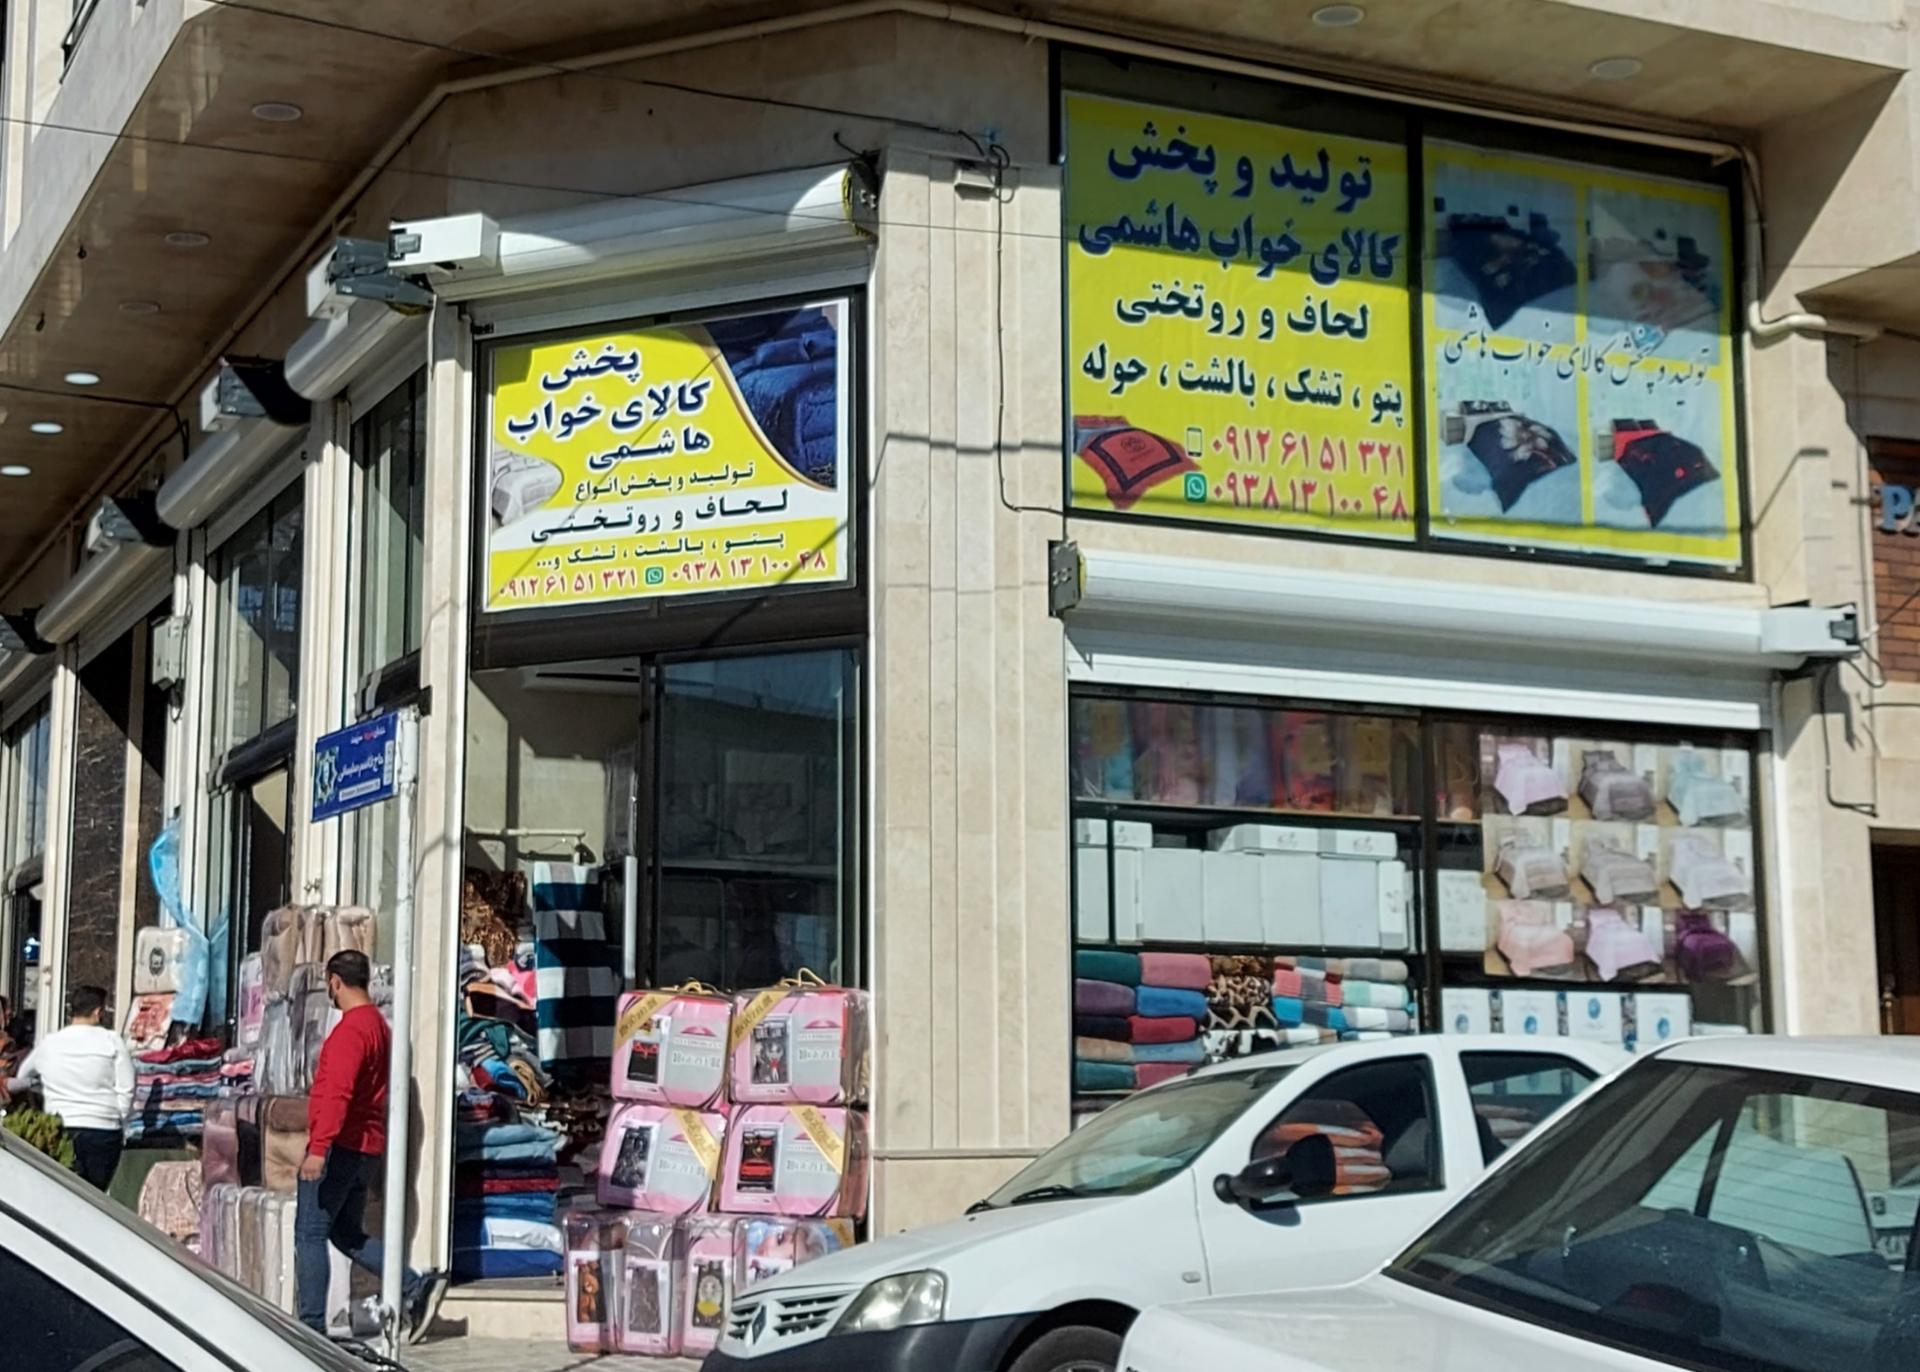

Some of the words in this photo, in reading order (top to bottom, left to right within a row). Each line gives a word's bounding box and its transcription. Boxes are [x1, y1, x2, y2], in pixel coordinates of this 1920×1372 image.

[1107, 121, 1218, 195] پخش
[1232, 154, 1255, 198] و
[1269, 147, 1373, 213] تولید
[1078, 200, 1201, 256] هاشمی
[1208, 213, 1303, 278] خواب
[1309, 226, 1400, 286] کالای
[1115, 280, 1246, 336] روتختی
[1260, 307, 1275, 340] و
[1287, 296, 1370, 339] لحاف
[542, 345, 641, 391] پخش
[1082, 343, 1149, 395] حوله
[1492, 321, 1553, 376] خواب
[1556, 340, 1615, 380] کالای
[1178, 357, 1256, 408] بالشت
[1285, 369, 1343, 407] تشک
[1668, 347, 1709, 406] تولید
[507, 396, 602, 439] خواب
[611, 380, 711, 429] کالای
[1370, 382, 1405, 428] پتو
[589, 427, 711, 470] هاشمی
[1212, 425, 1271, 472] ۰۹۱۲
[1281, 431, 1311, 469] ۶۱
[1319, 436, 1348, 473] ۵۱
[1358, 440, 1406, 478] ۳۲۱
[575, 476, 618, 501] انواع
[622, 470, 672, 494] پخش
[678, 474, 684, 490] و
[689, 462, 754, 485] تولید
[531, 506, 661, 544] روتختی
[674, 511, 684, 530] و
[696, 489, 789, 520] لحاف
[567, 547, 616, 564] تشک
[634, 538, 704, 558] بالشت
[724, 532, 784, 552] پتو
[499, 574, 538, 598] ۰۹۱۲
[544, 573, 566, 594] ۶۱
[574, 572, 595, 592] ۵۱
[603, 568, 636, 588] ۳۲۱
[672, 557, 722, 582] ۰۹۳۸
[730, 556, 752, 578] ۱۳
